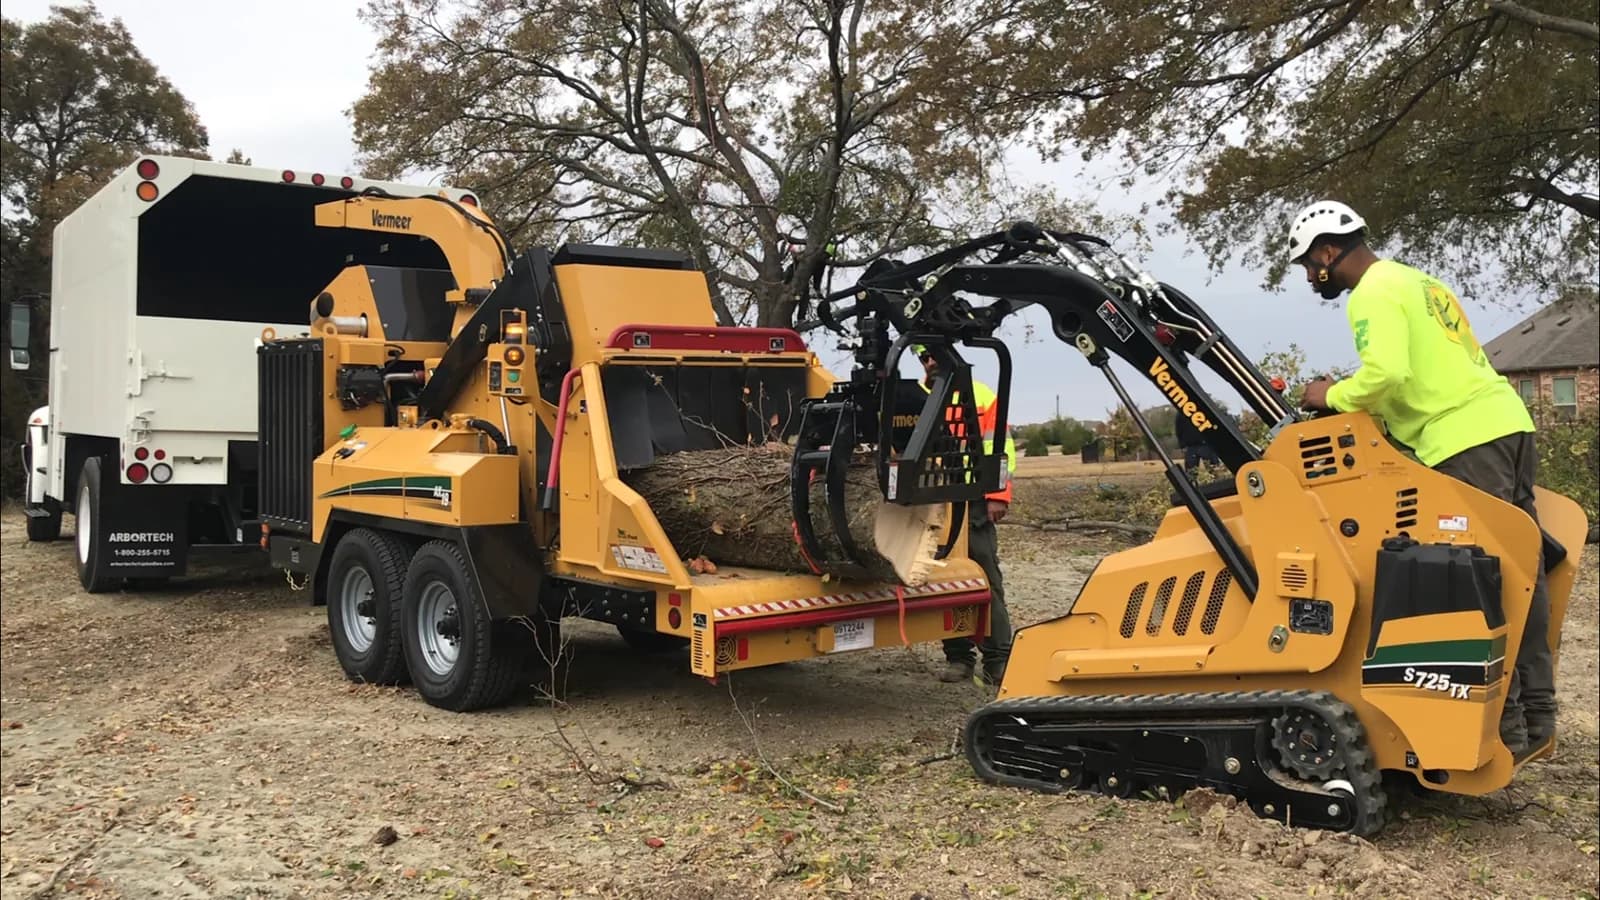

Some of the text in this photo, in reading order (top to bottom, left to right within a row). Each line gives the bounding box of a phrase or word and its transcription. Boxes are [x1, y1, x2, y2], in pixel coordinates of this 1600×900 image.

[371, 208, 412, 231] Vermeer
[1149, 356, 1213, 432] Vermeer
[108, 532, 174, 542] ARBORTECH
